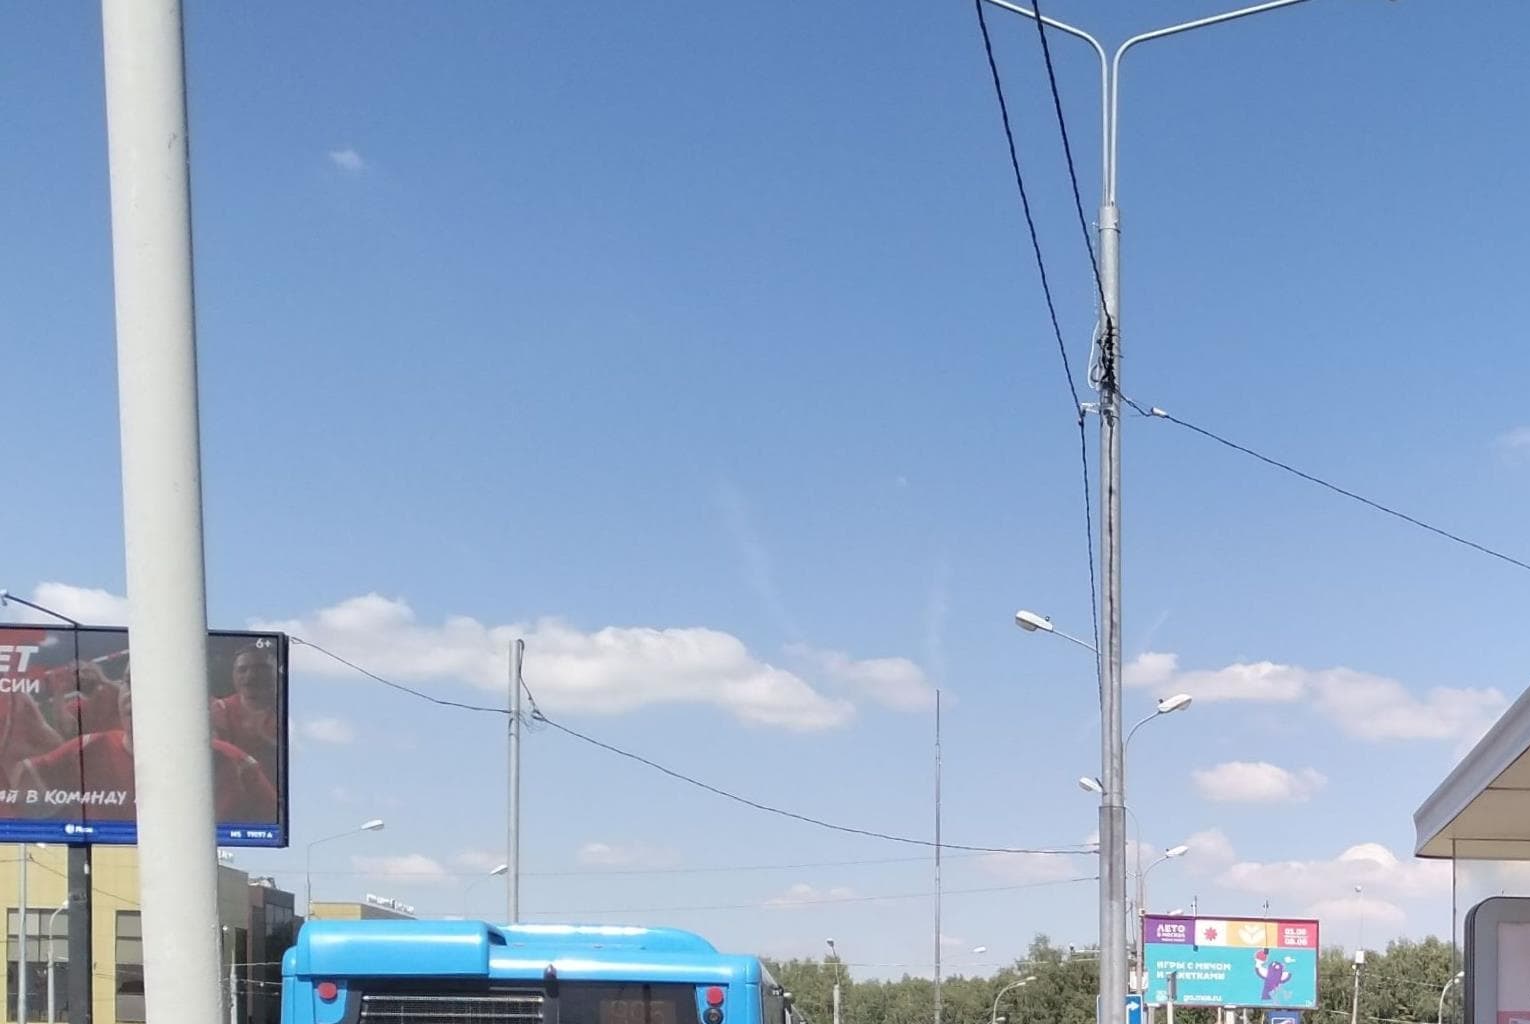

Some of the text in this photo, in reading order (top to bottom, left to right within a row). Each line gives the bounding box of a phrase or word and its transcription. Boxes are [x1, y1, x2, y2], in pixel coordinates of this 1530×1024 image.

[26, 789, 39, 804] В
[44, 788, 128, 806] КОМАНДУ
[1158, 923, 1186, 933] ЛЕТО
